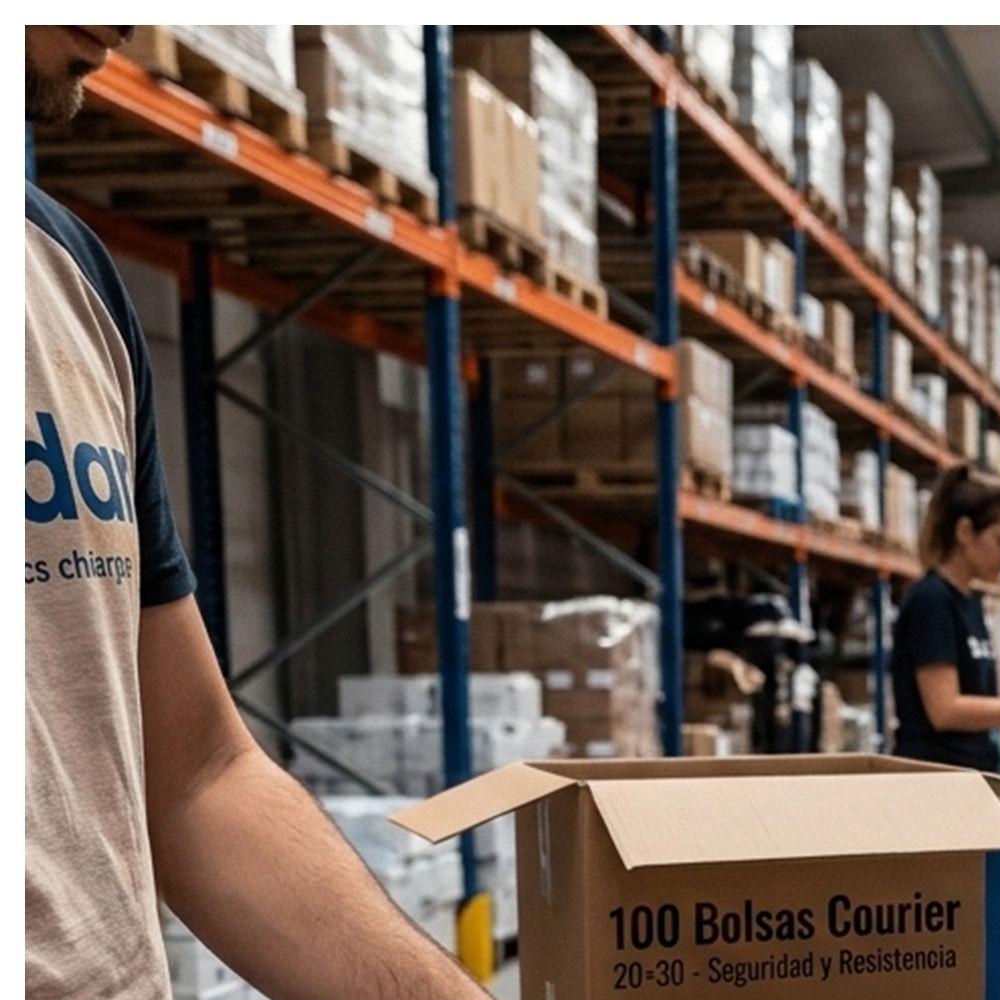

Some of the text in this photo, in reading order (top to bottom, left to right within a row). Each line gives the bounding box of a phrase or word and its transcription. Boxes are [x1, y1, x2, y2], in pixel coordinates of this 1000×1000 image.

[609, 892, 961, 950] 100 Bolsas Courier
[708, 952, 814, 988] Seguridad
[820, 955, 833, 982] y
[839, 945, 957, 975] Resistencia
